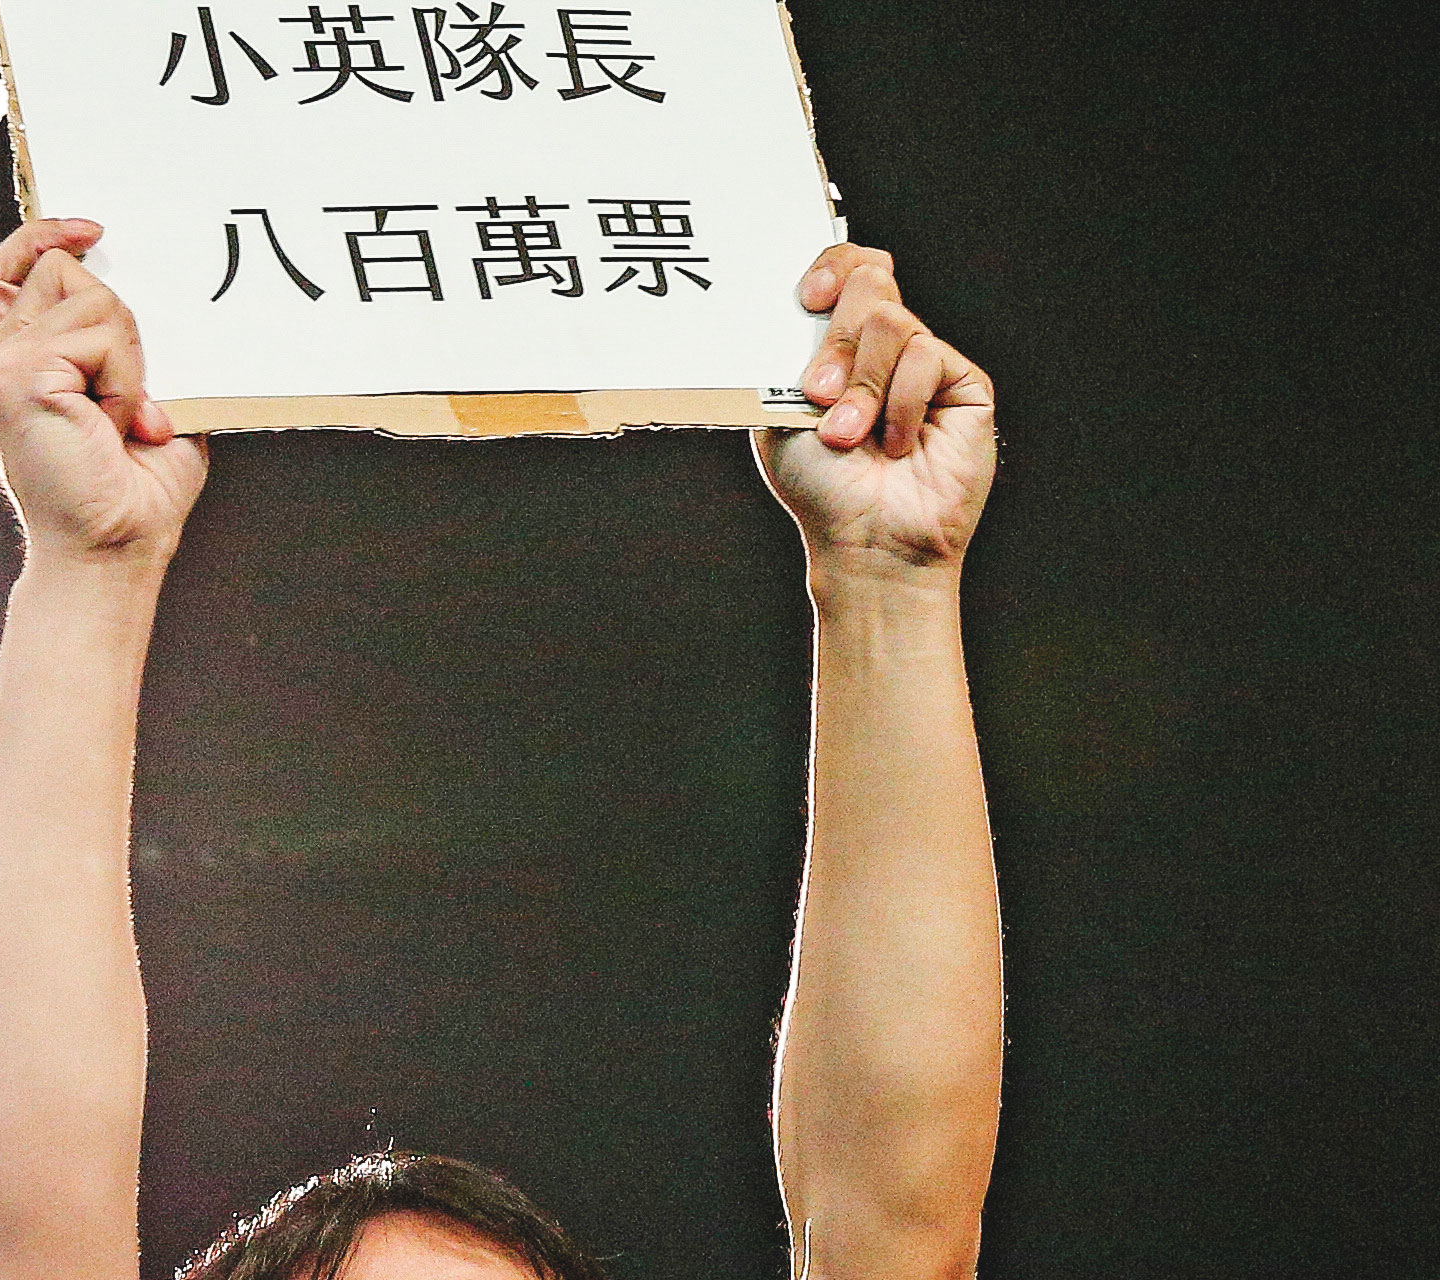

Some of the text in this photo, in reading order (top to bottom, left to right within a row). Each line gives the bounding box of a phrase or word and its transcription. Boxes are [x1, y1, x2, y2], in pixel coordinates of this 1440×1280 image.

[159, 1, 666, 106] 小英隊長
[210, 195, 712, 303] 八百萬票
